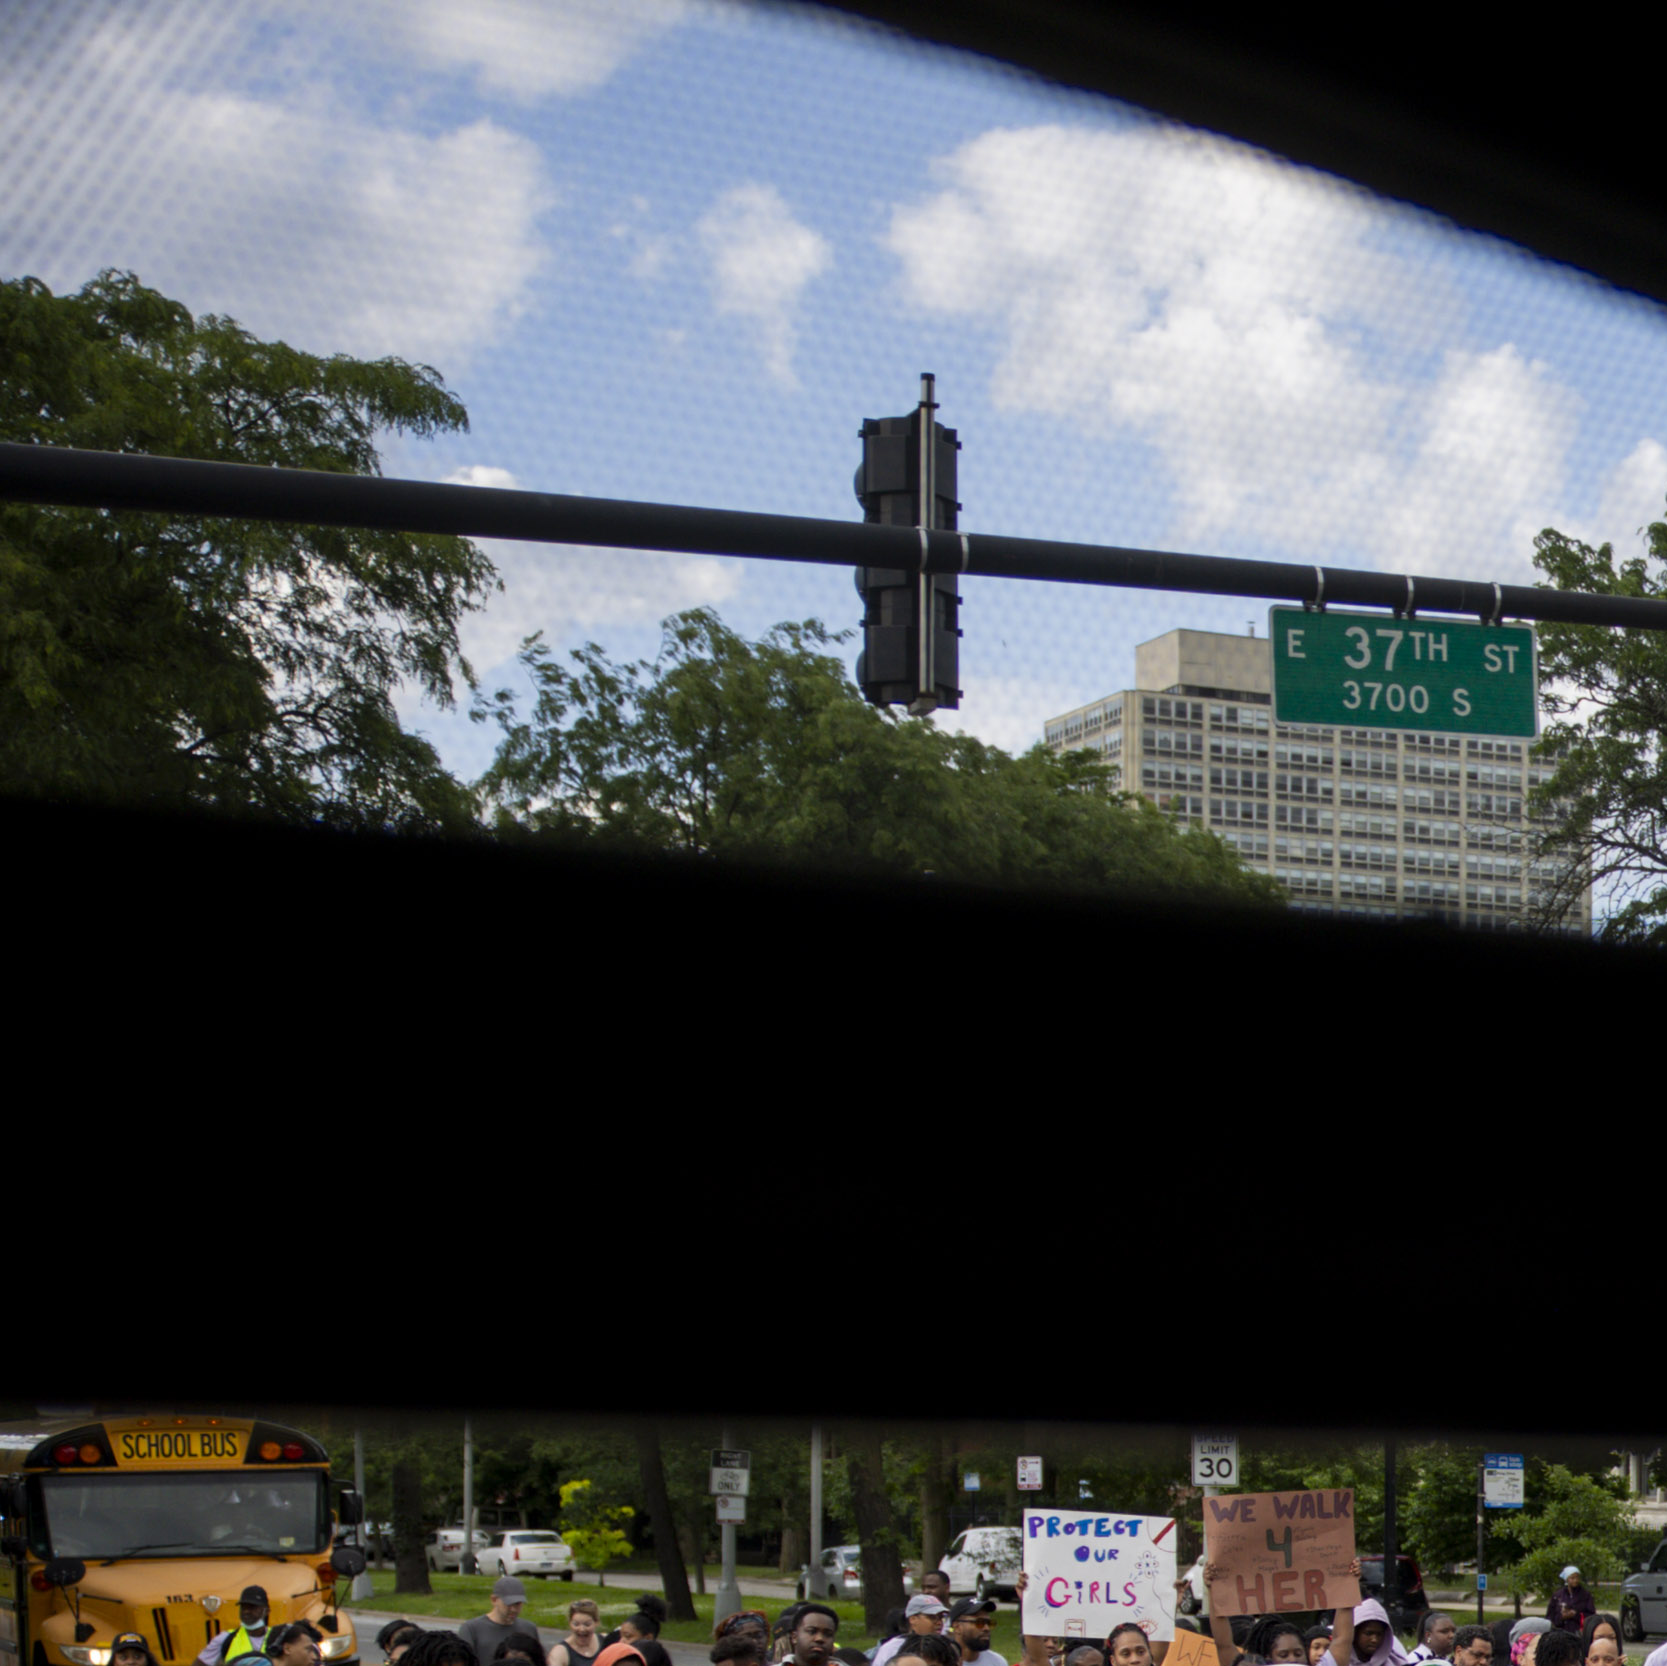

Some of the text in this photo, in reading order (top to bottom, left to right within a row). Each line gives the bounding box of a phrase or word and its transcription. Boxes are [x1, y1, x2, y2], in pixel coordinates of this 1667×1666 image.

[1287, 627, 1519, 674] E 37TH ST
[1343, 681, 1472, 717] 3700 S
[122, 1432, 238, 1459] SCHOOL BUS
[1201, 1445, 1231, 1455] LIMIT
[1200, 1458, 1233, 1478] 30
[1209, 1492, 1350, 1522] WE WALK
[1074, 1545, 1119, 1562] OUR
[1266, 1526, 1292, 1568] 4
[1236, 1569, 1327, 1613] HER
